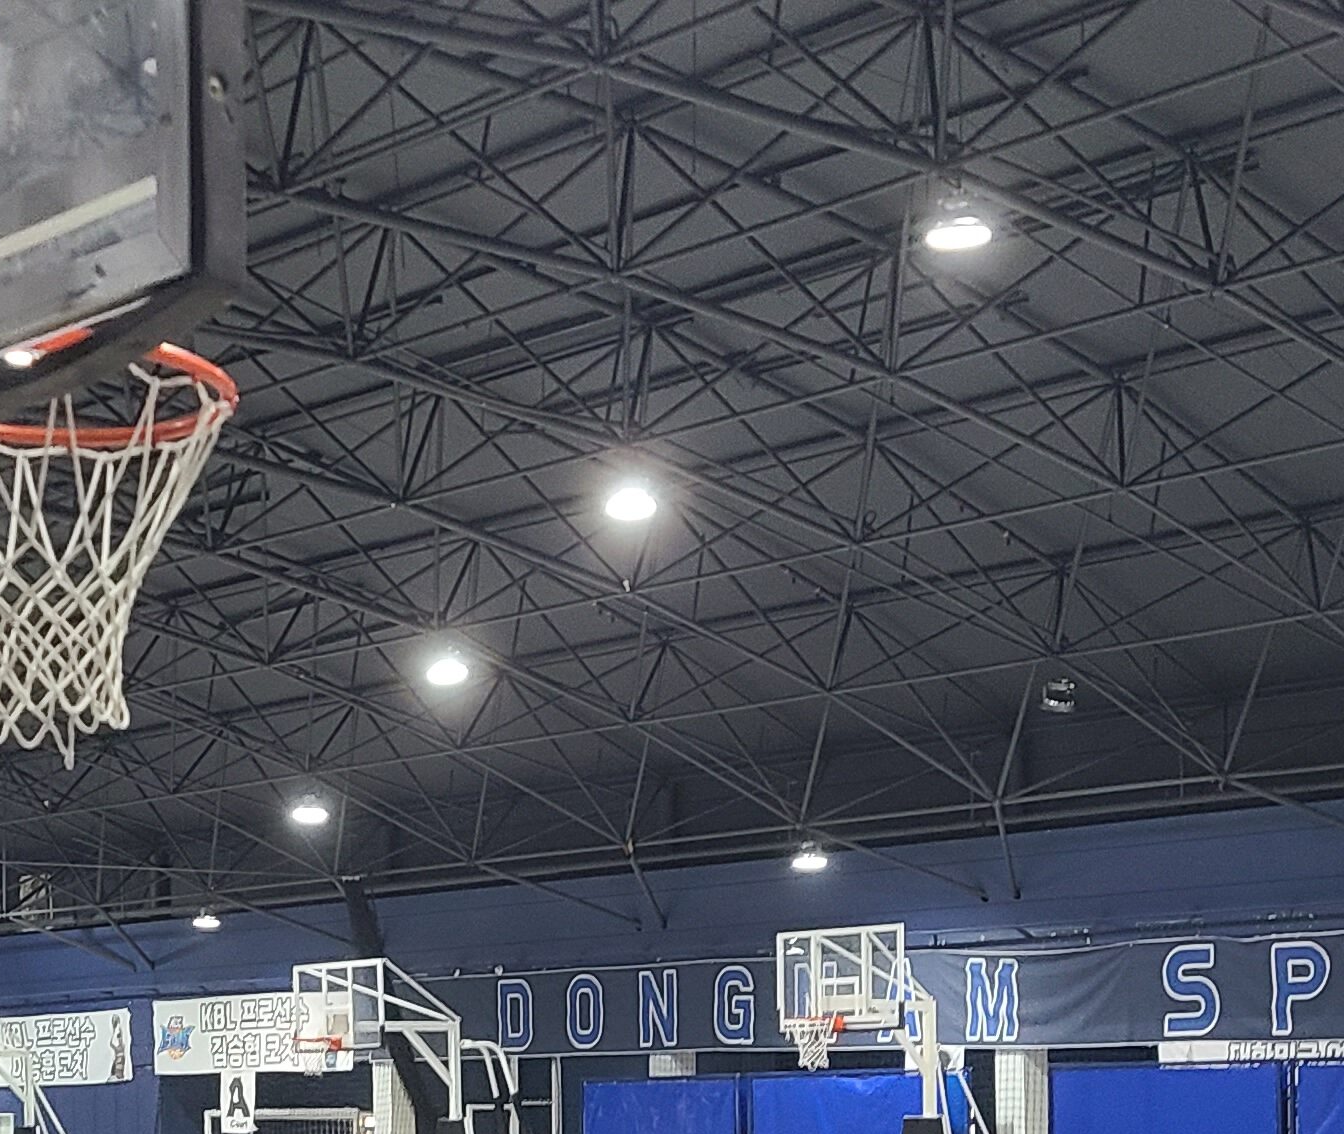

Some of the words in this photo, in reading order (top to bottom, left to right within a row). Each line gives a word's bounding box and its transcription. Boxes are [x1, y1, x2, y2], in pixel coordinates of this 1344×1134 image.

[200, 1001, 237, 1032] KBL
[240, 997, 309, 1032] 프로선수
[1, 1021, 34, 1050] KBL
[35, 1016, 96, 1048] 프로선수
[58, 1047, 88, 1080] 코치
[227, 1077, 250, 1118] A
